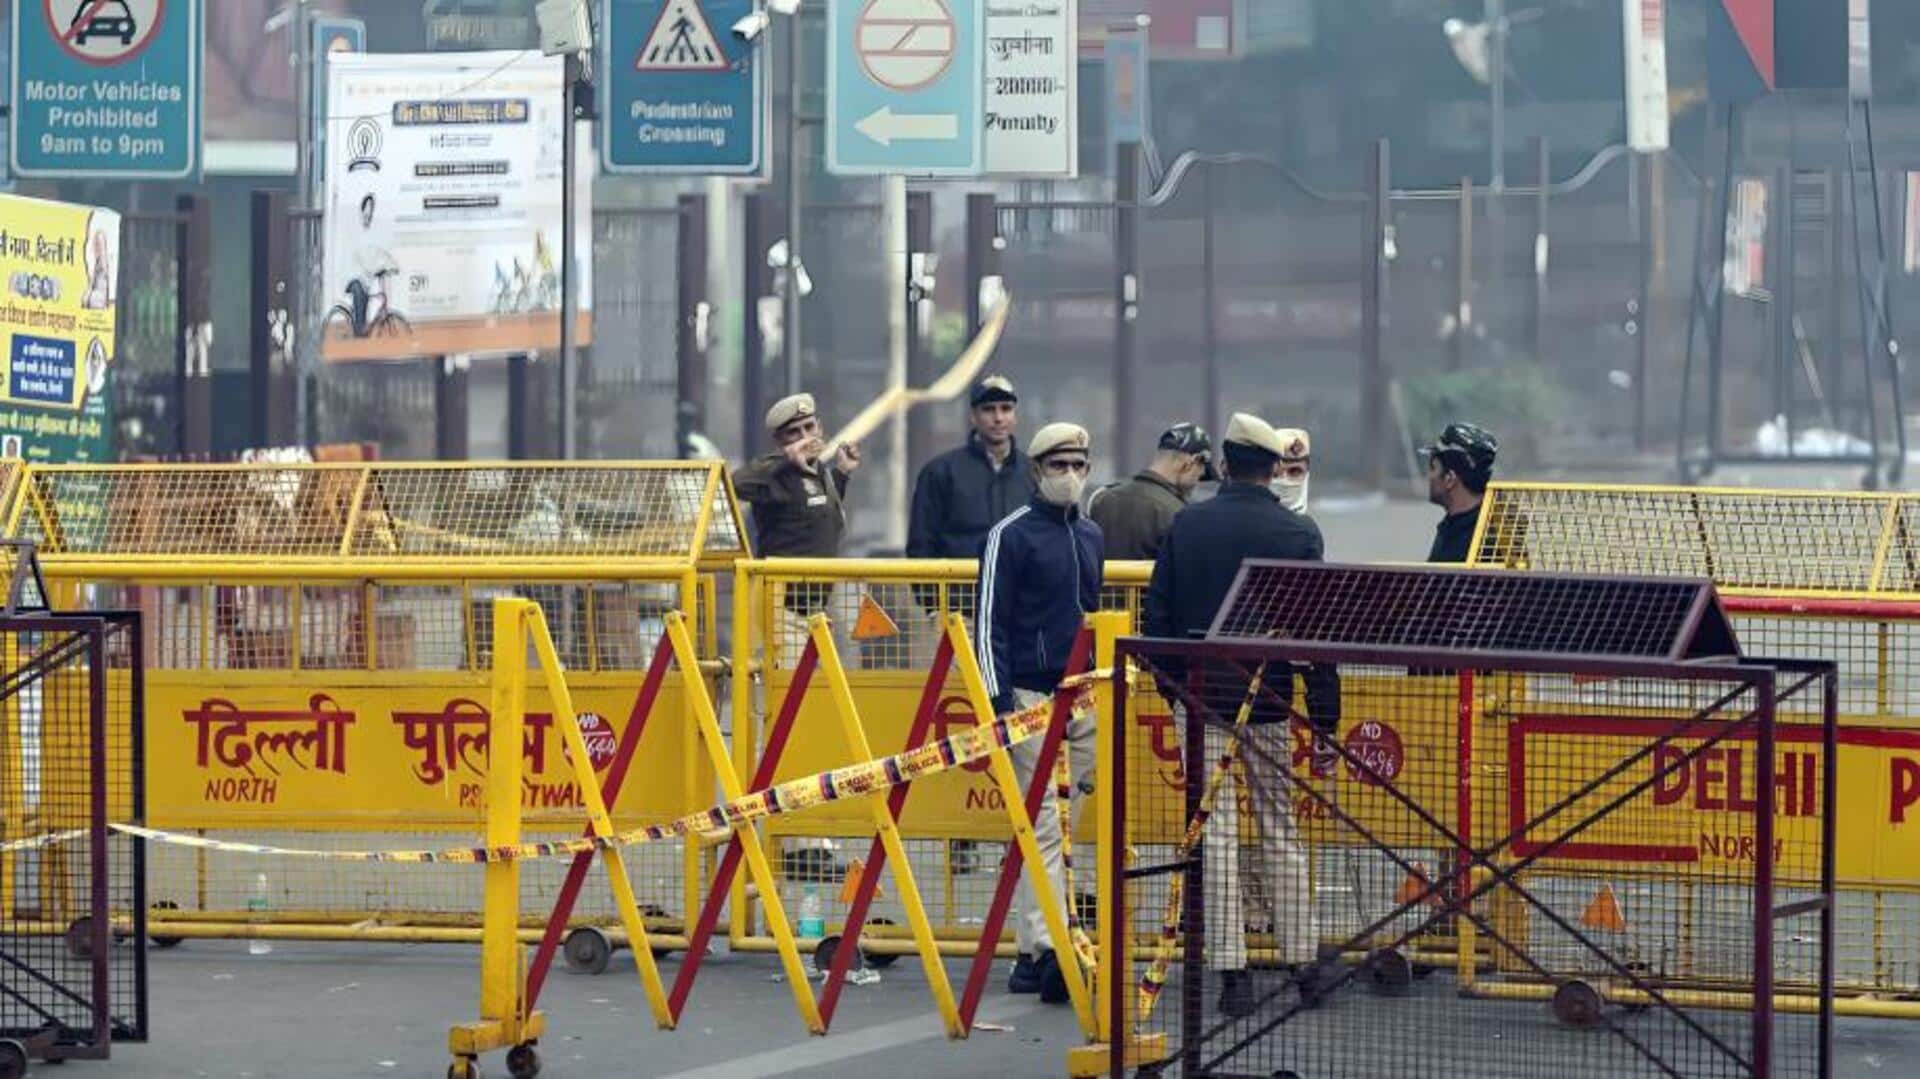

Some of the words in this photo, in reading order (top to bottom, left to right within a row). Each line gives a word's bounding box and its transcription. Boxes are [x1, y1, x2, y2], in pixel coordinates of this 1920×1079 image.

[26, 81, 87, 101] Motor
[93, 80, 182, 101] Vehicles
[49, 106, 158, 127] Prohibited
[631, 100, 733, 119] Pedestrian
[41, 133, 86, 153] 9am
[92, 135, 112, 153] to
[119, 133, 164, 159] 9pm
[639, 123, 725, 146] Crossing
[182, 693, 356, 775] दिल्ली
[1361, 721, 1381, 740] ND
[205, 777, 277, 803] NORTH
[1654, 743, 1816, 817] DELHI
